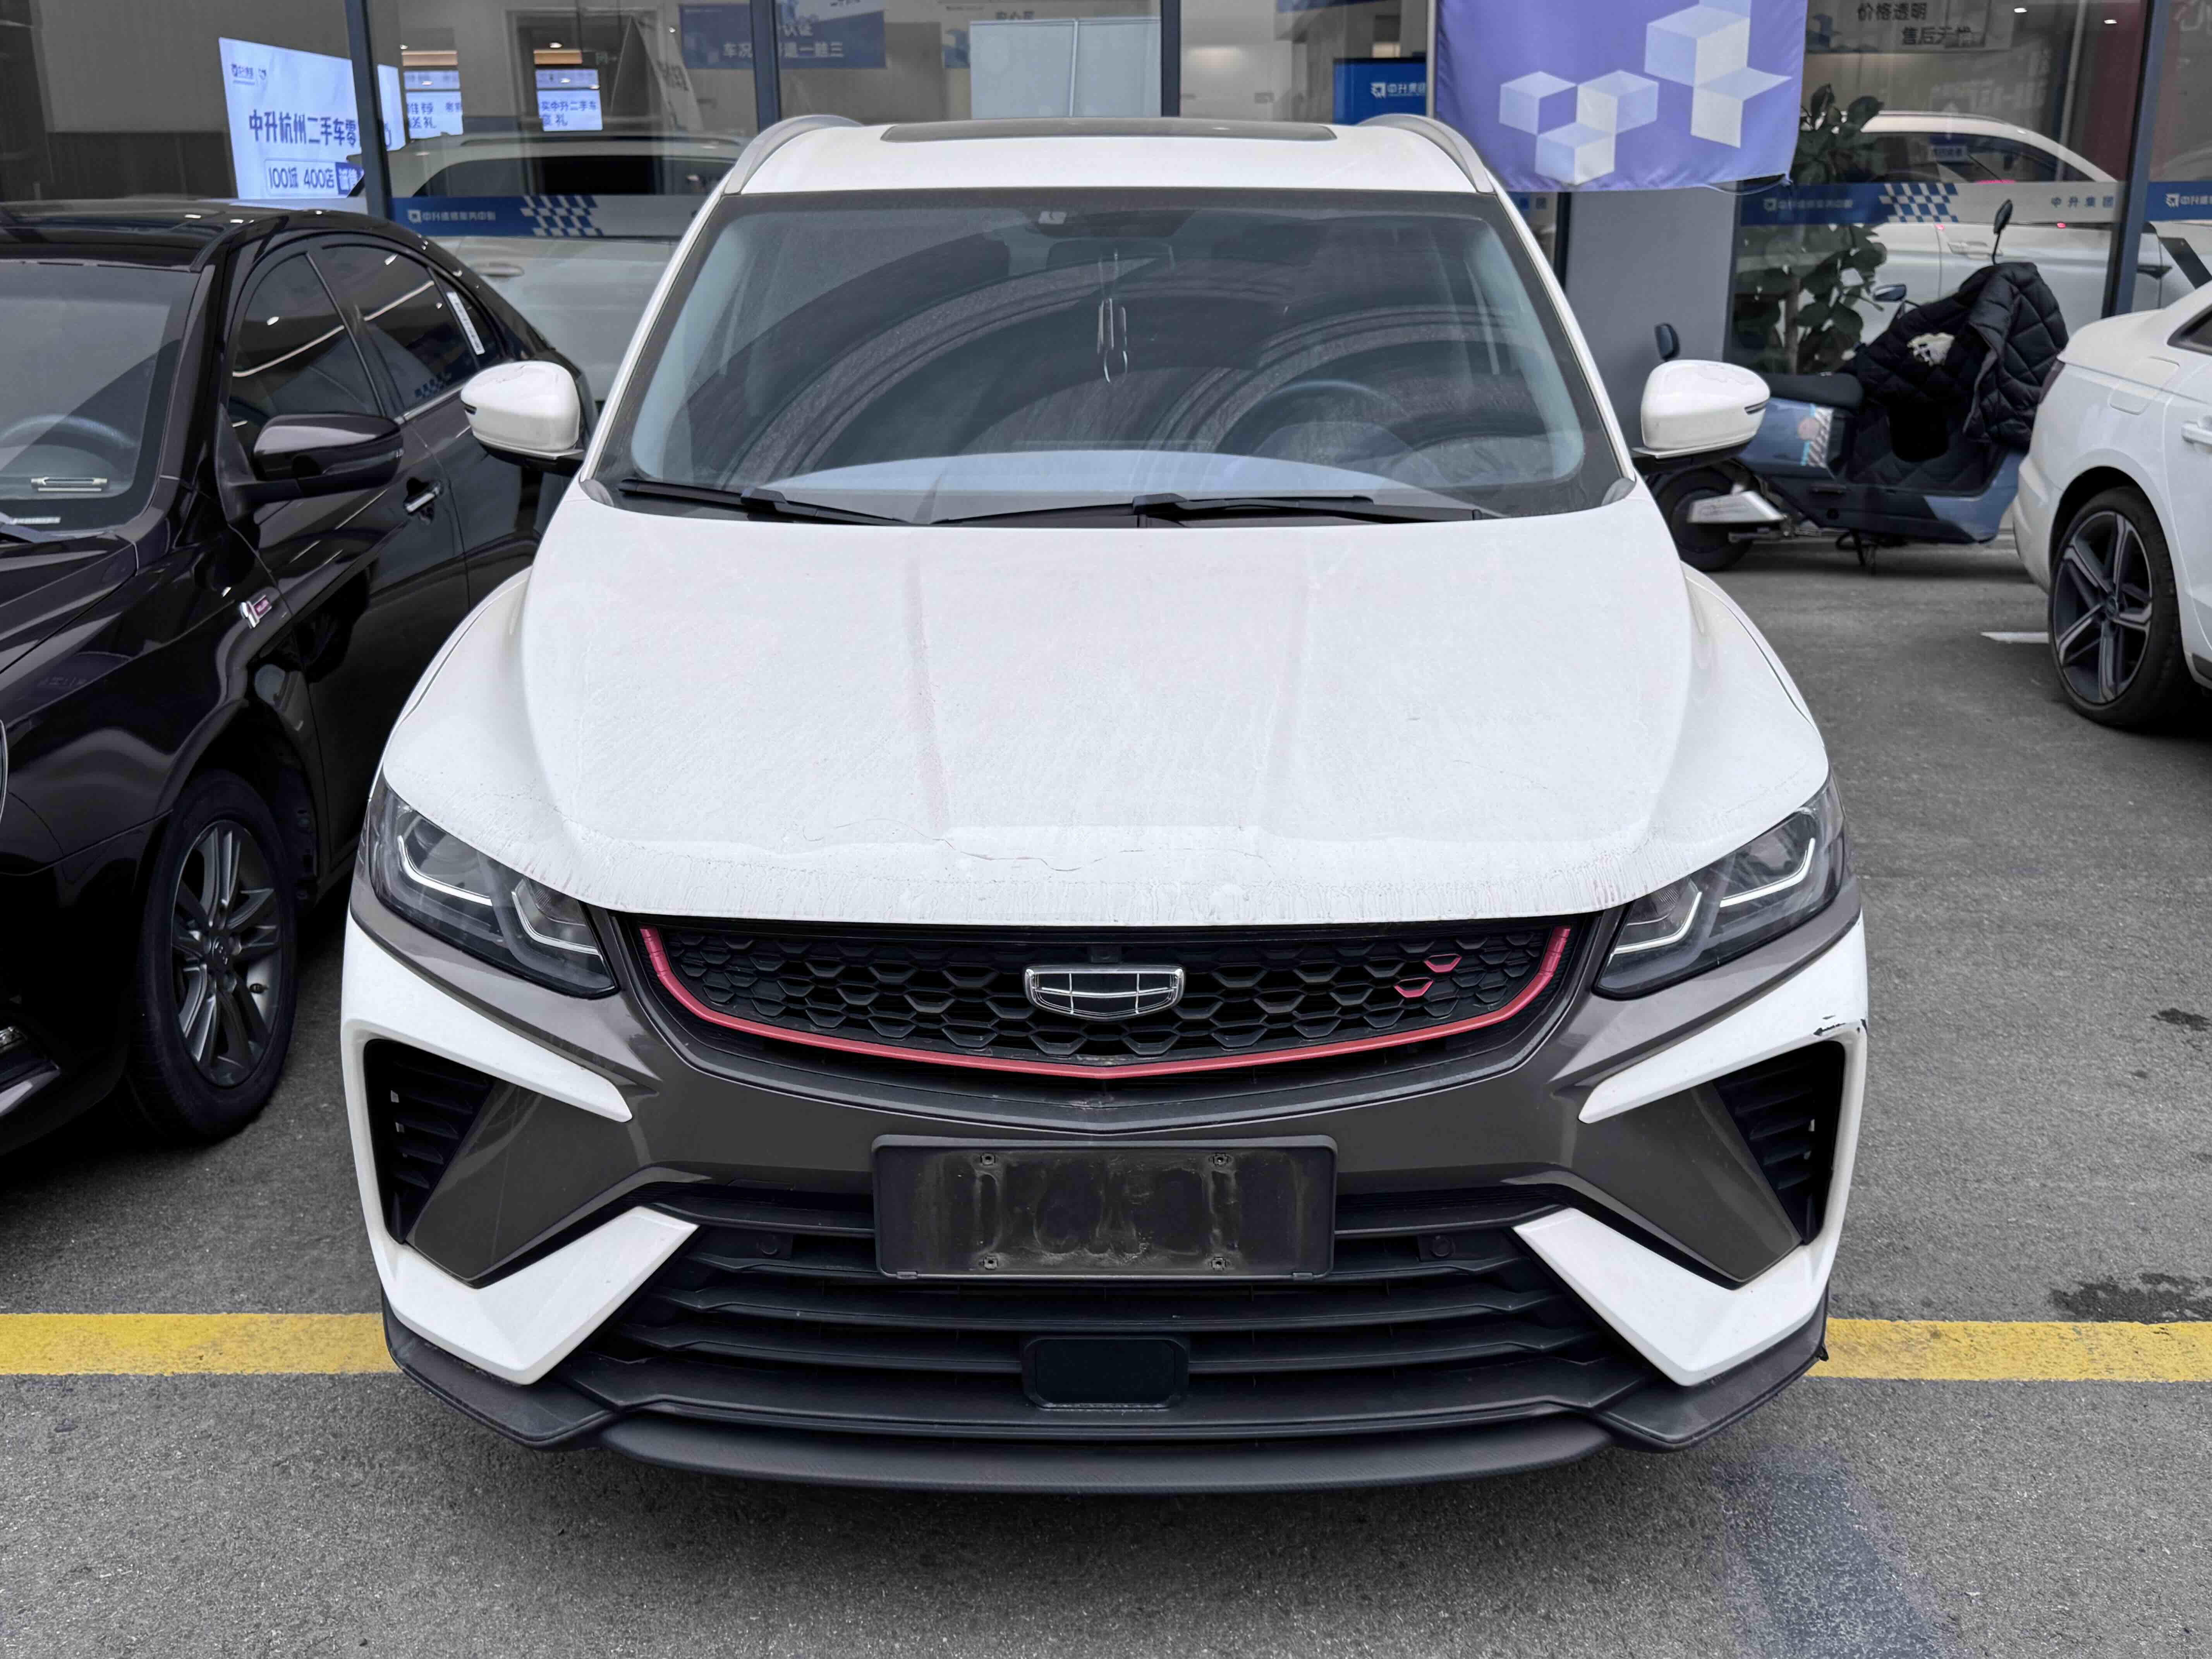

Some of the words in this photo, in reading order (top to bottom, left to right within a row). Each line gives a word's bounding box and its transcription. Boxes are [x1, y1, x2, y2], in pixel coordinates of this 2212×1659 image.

[1858, 2, 1927, 20] 价格透明
[249, 109, 357, 148] 中升杭州二手车零
